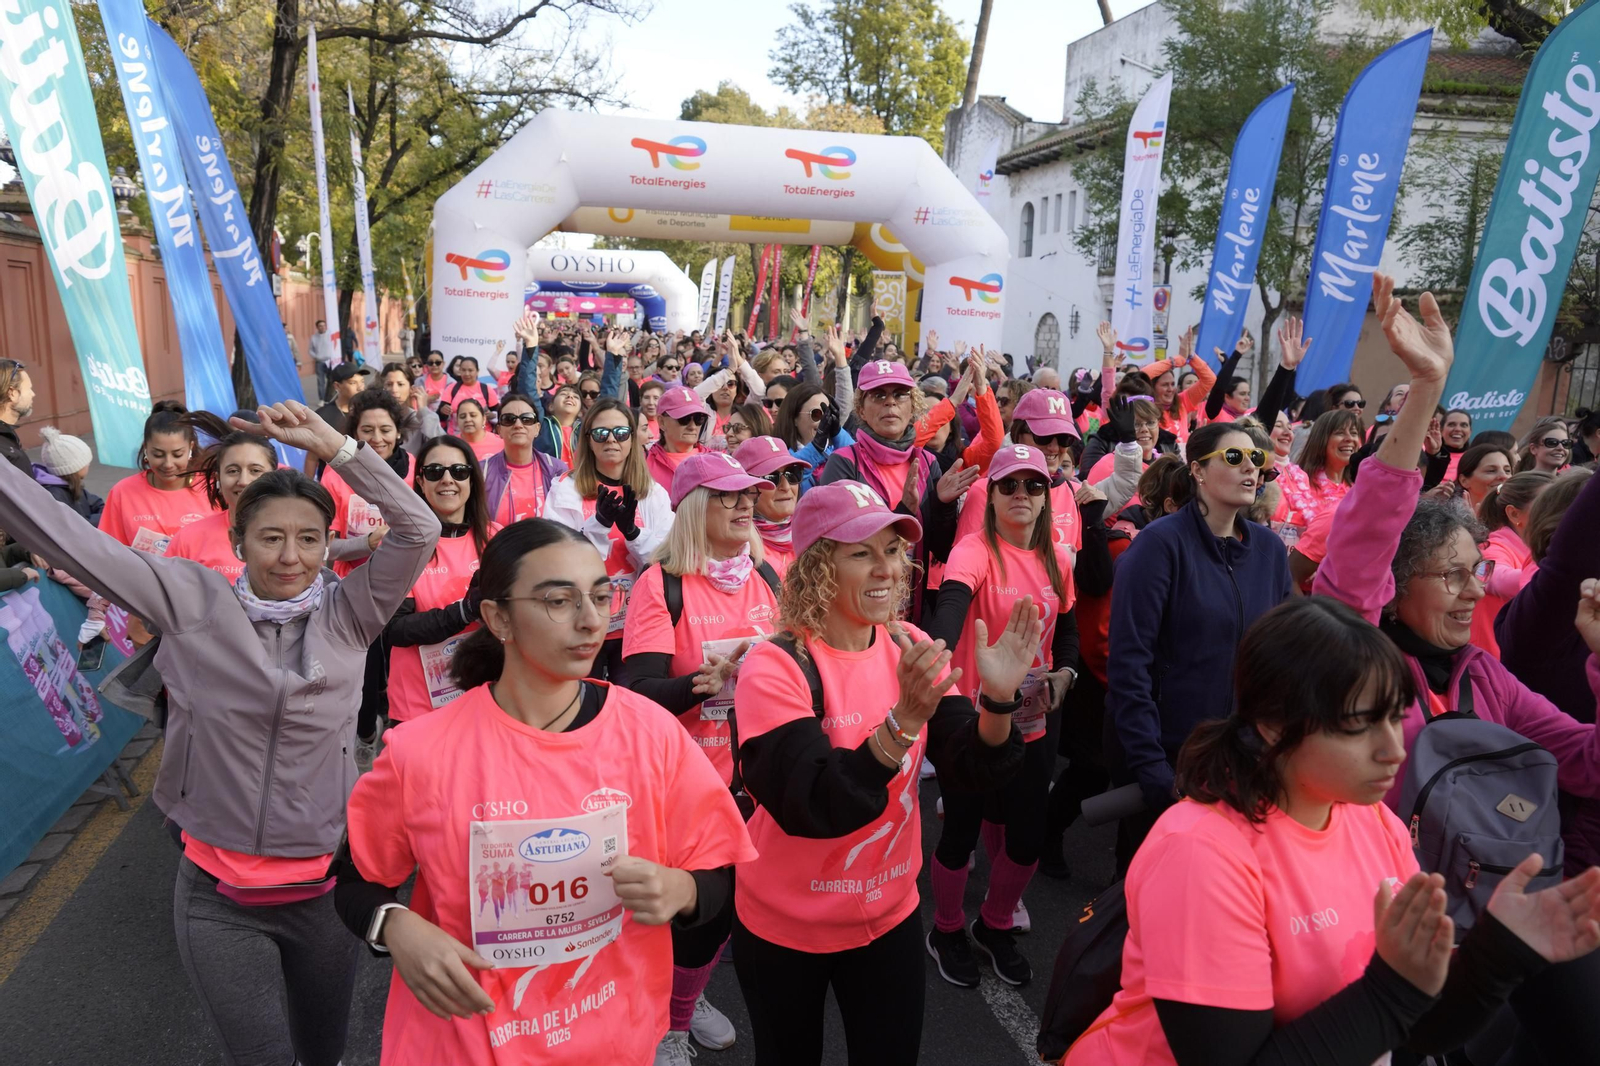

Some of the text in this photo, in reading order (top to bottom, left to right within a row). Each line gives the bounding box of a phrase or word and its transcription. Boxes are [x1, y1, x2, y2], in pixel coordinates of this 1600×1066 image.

[629, 174, 706, 190] TotalEnergies
[783, 184, 855, 199] TotalEnergies
[1478, 64, 1600, 347] Batiste
[657, 218, 706, 228] de Deportes
[1318, 152, 1387, 302] Marlene
[1214, 188, 1260, 315] Marlene
[551, 254, 635, 274] OYSHO
[444, 286, 509, 301] TotalEnergies
[877, 360, 894, 375] R
[682, 389, 693, 402] I
[1447, 389, 1524, 411] Batiste
[1048, 396, 1067, 416] M
[764, 435, 781, 452] I
[1014, 446, 1031, 460] S
[845, 483, 885, 508] M
[368, 517, 387, 527] 01
[689, 614, 725, 625] OYSHO
[821, 712, 862, 730] OYSHO
[472, 800, 528, 819] OYSHO
[482, 848, 515, 859] SUMA
[524, 839, 586, 856] ASTURIANA
[529, 876, 589, 906] 016
[810, 879, 863, 894] CARRERA
[866, 876, 877, 891] DE
[879, 870, 888, 886] LA
[865, 888, 883, 904] 2025
[497, 913, 611, 941] CARRERA DE LA MUJER SEVILLA
[546, 911, 575, 925] 6752
[1290, 907, 1340, 936] OYSHO
[493, 927, 613, 960] OYSHO Santander
[543, 1010, 561, 1032] DE
[564, 1003, 579, 1025] LA
[580, 980, 616, 1015] MUJER
[546, 1027, 571, 1048] 2025
